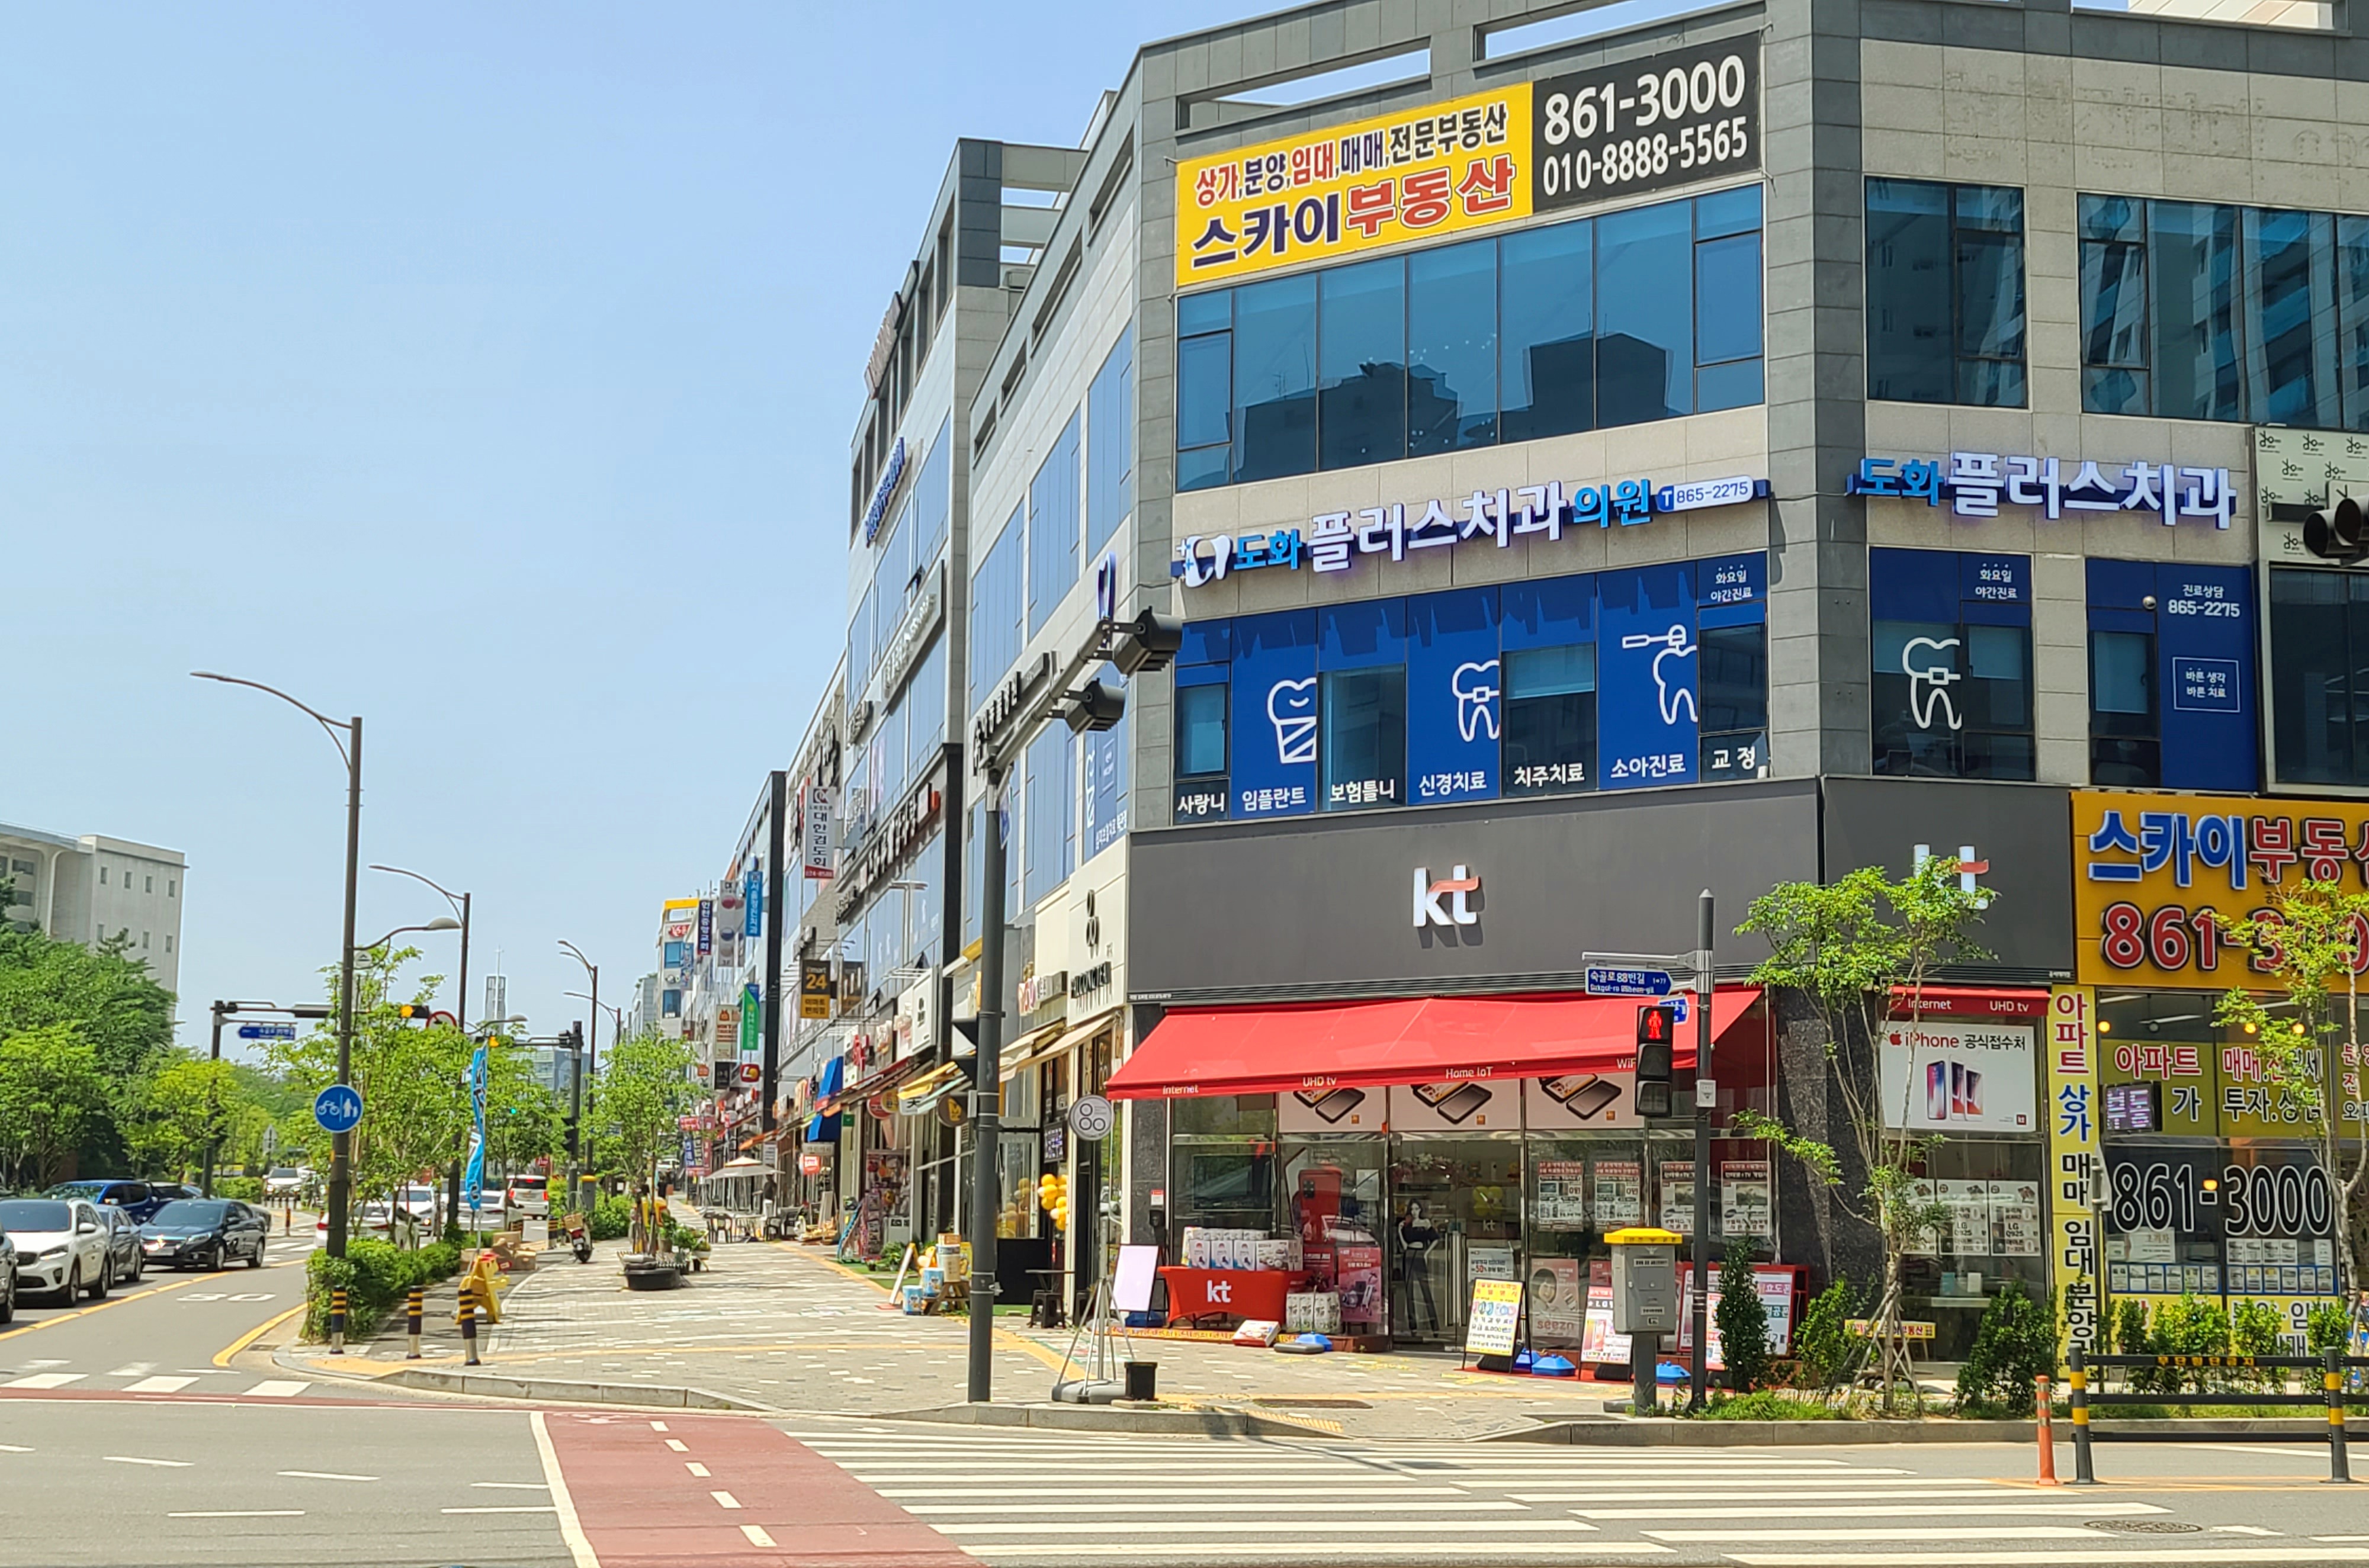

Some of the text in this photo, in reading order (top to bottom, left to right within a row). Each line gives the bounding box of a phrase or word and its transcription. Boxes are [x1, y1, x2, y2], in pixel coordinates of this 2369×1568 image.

[1545, 54, 1746, 145] 861-3000
[1543, 117, 1747, 196] 010-8888-5565
[1675, 480, 1748, 505] 865-2275
[1715, 569, 1747, 585] 화요일
[1980, 568, 2012, 583] 화요일
[1710, 587, 1752, 602] 야간진료
[1975, 586, 2017, 599] 야간진료
[2182, 584, 2224, 599] 진료상담
[2168, 600, 2240, 617] 865-2275
[1514, 763, 1584, 787] 치주치료
[1611, 753, 1686, 779] 소아진료
[1330, 779, 1395, 802] 보험틀니
[1418, 771, 1487, 796] 신경치료
[1177, 792, 1225, 815] 사랑니
[1242, 787, 1307, 811] 임플란트
[1414, 865, 1479, 927] kt
[806, 974, 827, 989] 24
[1990, 1001, 2014, 1011] UHD
[2017, 1003, 2028, 1012] tv
[1906, 1032, 2025, 1050] iPhone 공식접수처
[2055, 993, 2089, 1074] 아파트
[2115, 1044, 2203, 1079] 아파트
[1303, 1076, 1337, 1088] UHD tv
[1446, 1068, 1474, 1080] Home
[2059, 1084, 2091, 1142] 상가
[2113, 1162, 2333, 1235] 861-3000
[1483, 1220, 1495, 1232] kt
[2064, 1220, 2094, 1275] 임대
[1207, 1280, 1231, 1303] kt
[1537, 1320, 1574, 1330] seezn
